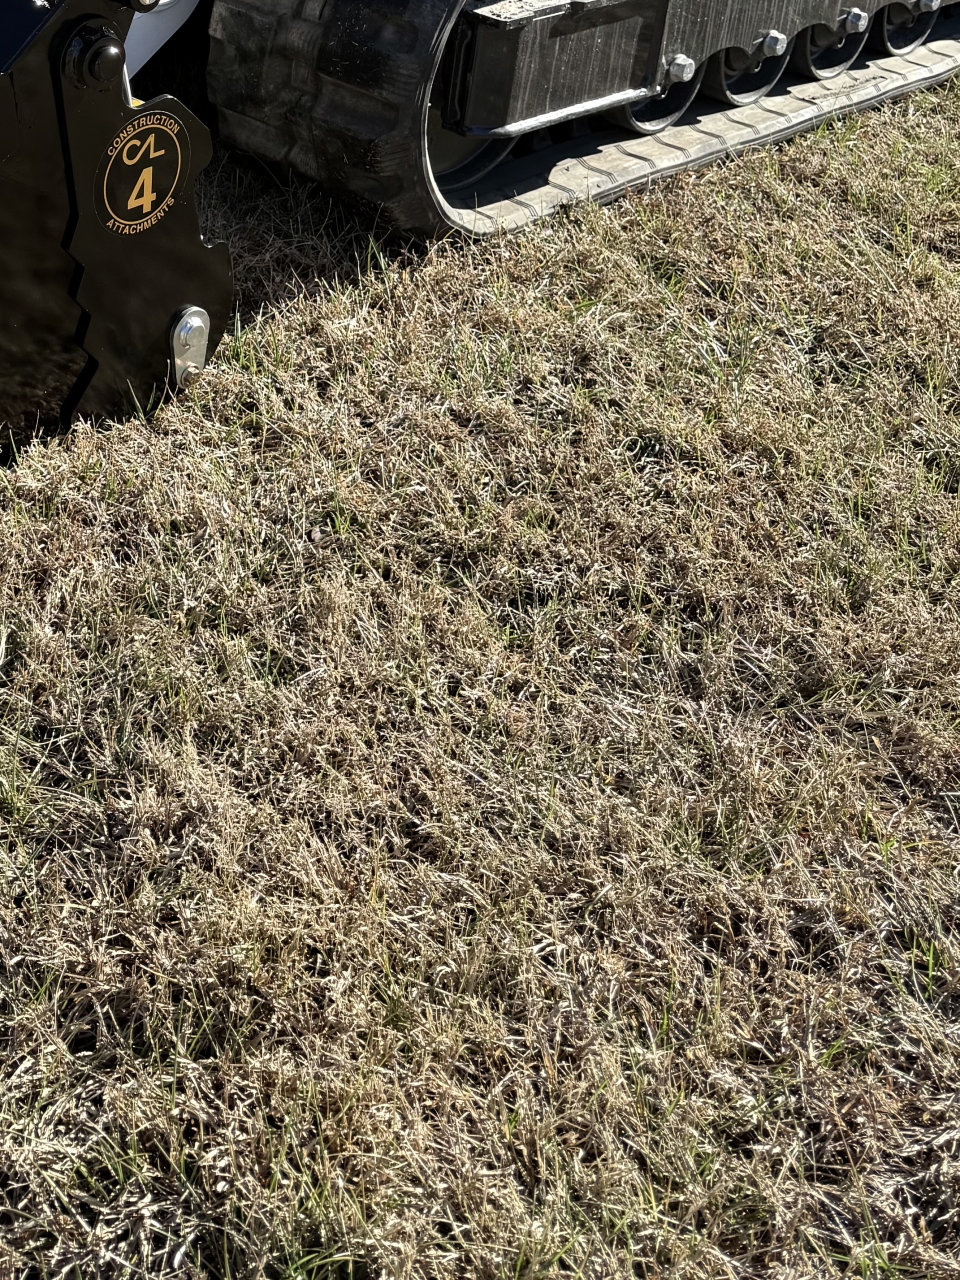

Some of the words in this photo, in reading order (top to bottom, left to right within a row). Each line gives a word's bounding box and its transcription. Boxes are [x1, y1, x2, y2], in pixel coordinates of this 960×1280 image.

[107, 115, 180, 156] CONSTRUCTION
[127, 166, 157, 214] 4
[106, 197, 175, 235] ATTACHMENTS
